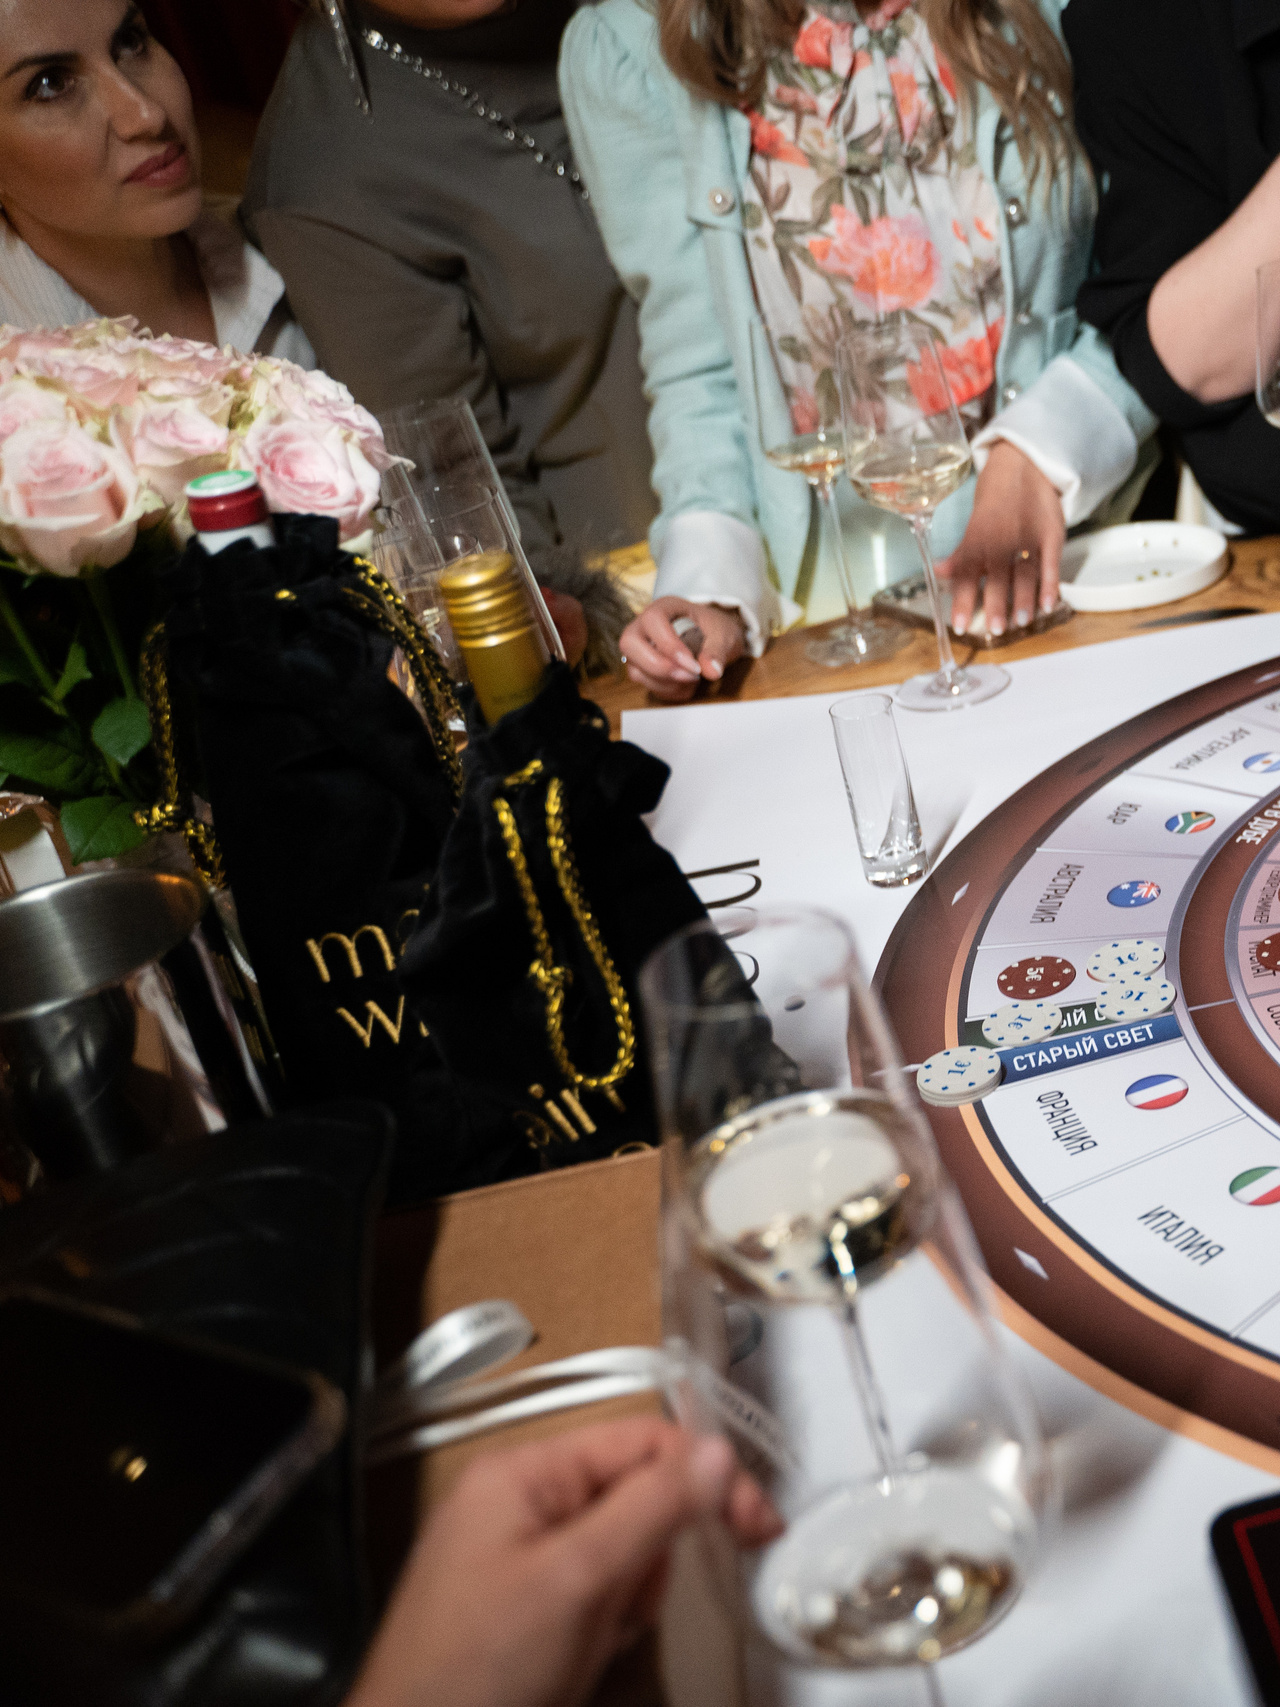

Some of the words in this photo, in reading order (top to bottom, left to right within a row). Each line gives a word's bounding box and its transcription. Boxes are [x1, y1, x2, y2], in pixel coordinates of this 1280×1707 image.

[1171, 726, 1251, 772] АРГЕНТИНА
[1106, 801, 1142, 826] ЮАР
[1236, 815, 1278, 846] ДУБЕ
[1030, 863, 1085, 924] АВСТРАЛИЯ
[1012, 1035, 1099, 1073] СТАРЫЙ
[1103, 1023, 1155, 1051] СВЕТ
[1036, 1089, 1099, 1156] ФРАНЦИЯ
[1137, 1204, 1226, 1266] ИТАЛИЯ
